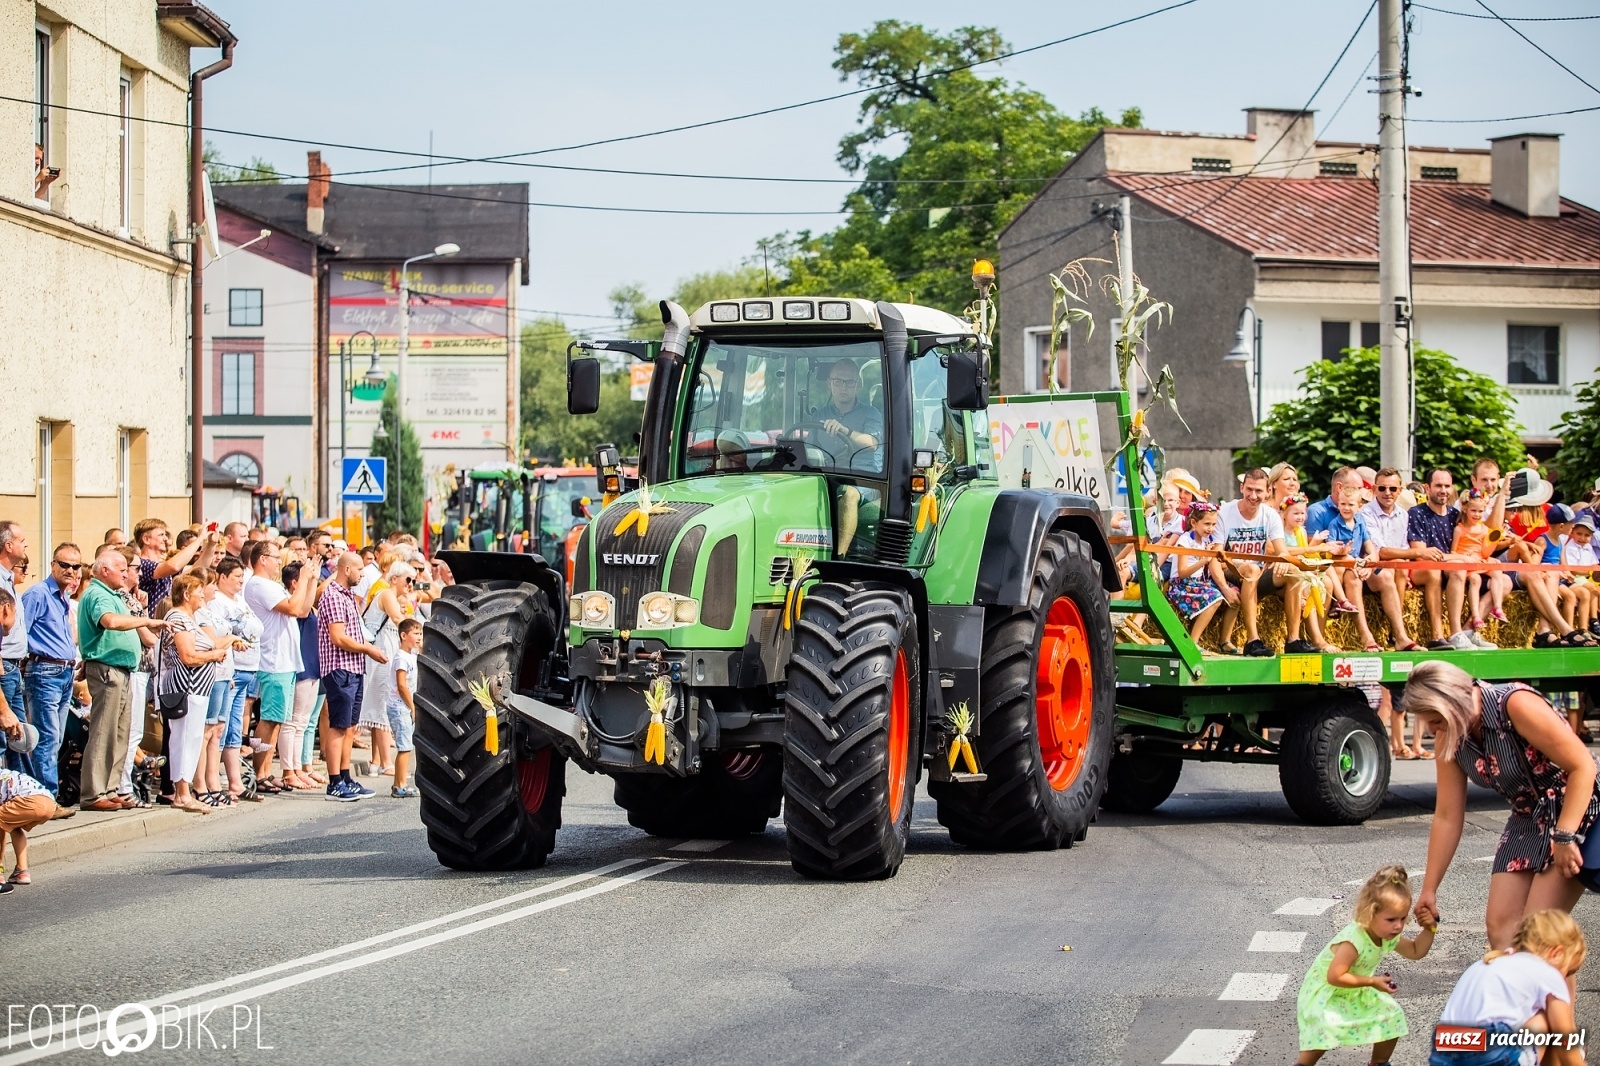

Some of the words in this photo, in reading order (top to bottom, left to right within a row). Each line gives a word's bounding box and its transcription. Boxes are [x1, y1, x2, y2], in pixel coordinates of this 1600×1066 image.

[1231, 542, 1262, 554] CUBA
[602, 553, 660, 565] FENDT
[1335, 664, 1353, 678] 24
